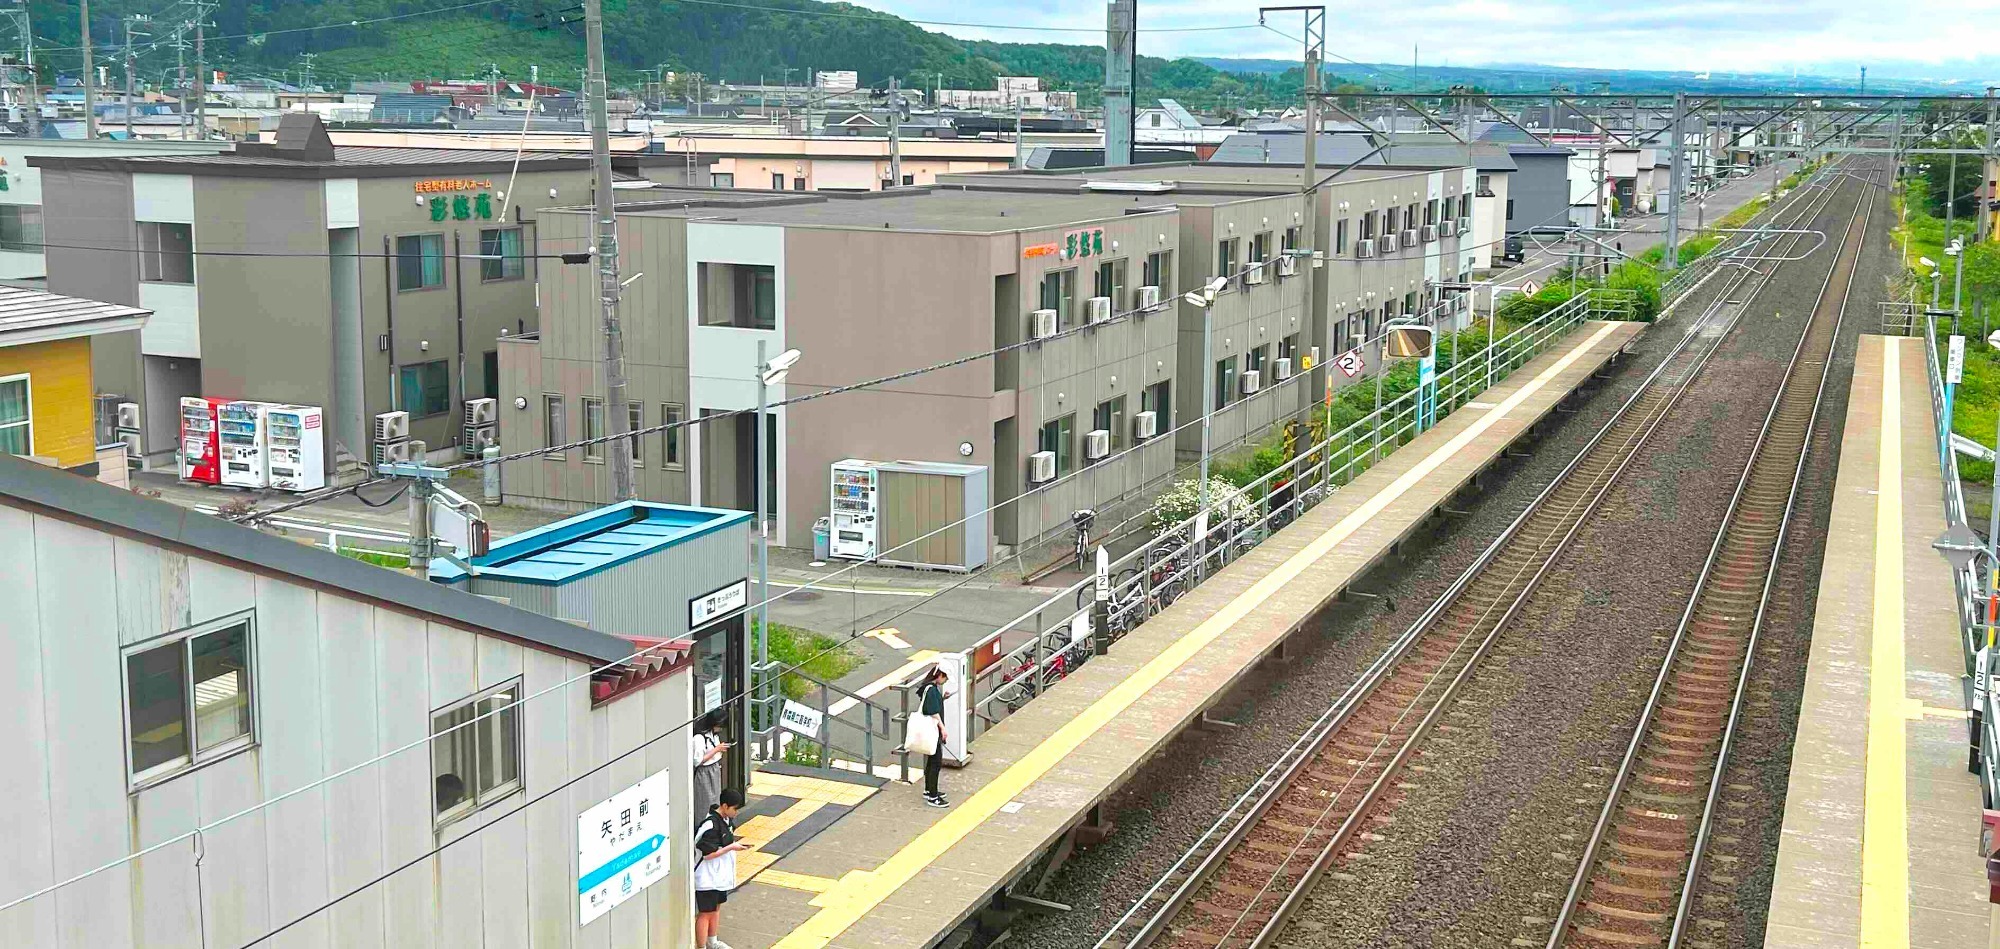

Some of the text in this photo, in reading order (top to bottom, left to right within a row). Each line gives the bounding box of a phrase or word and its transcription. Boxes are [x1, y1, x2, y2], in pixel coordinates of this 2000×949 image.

[1526, 283, 1532, 295] 4
[1343, 357, 1354, 370] 2
[1099, 577, 1106, 586] 2
[1976, 674, 1984, 686] 2
[601, 798, 650, 839] 矢田前
[610, 821, 643, 847] やだまえ
